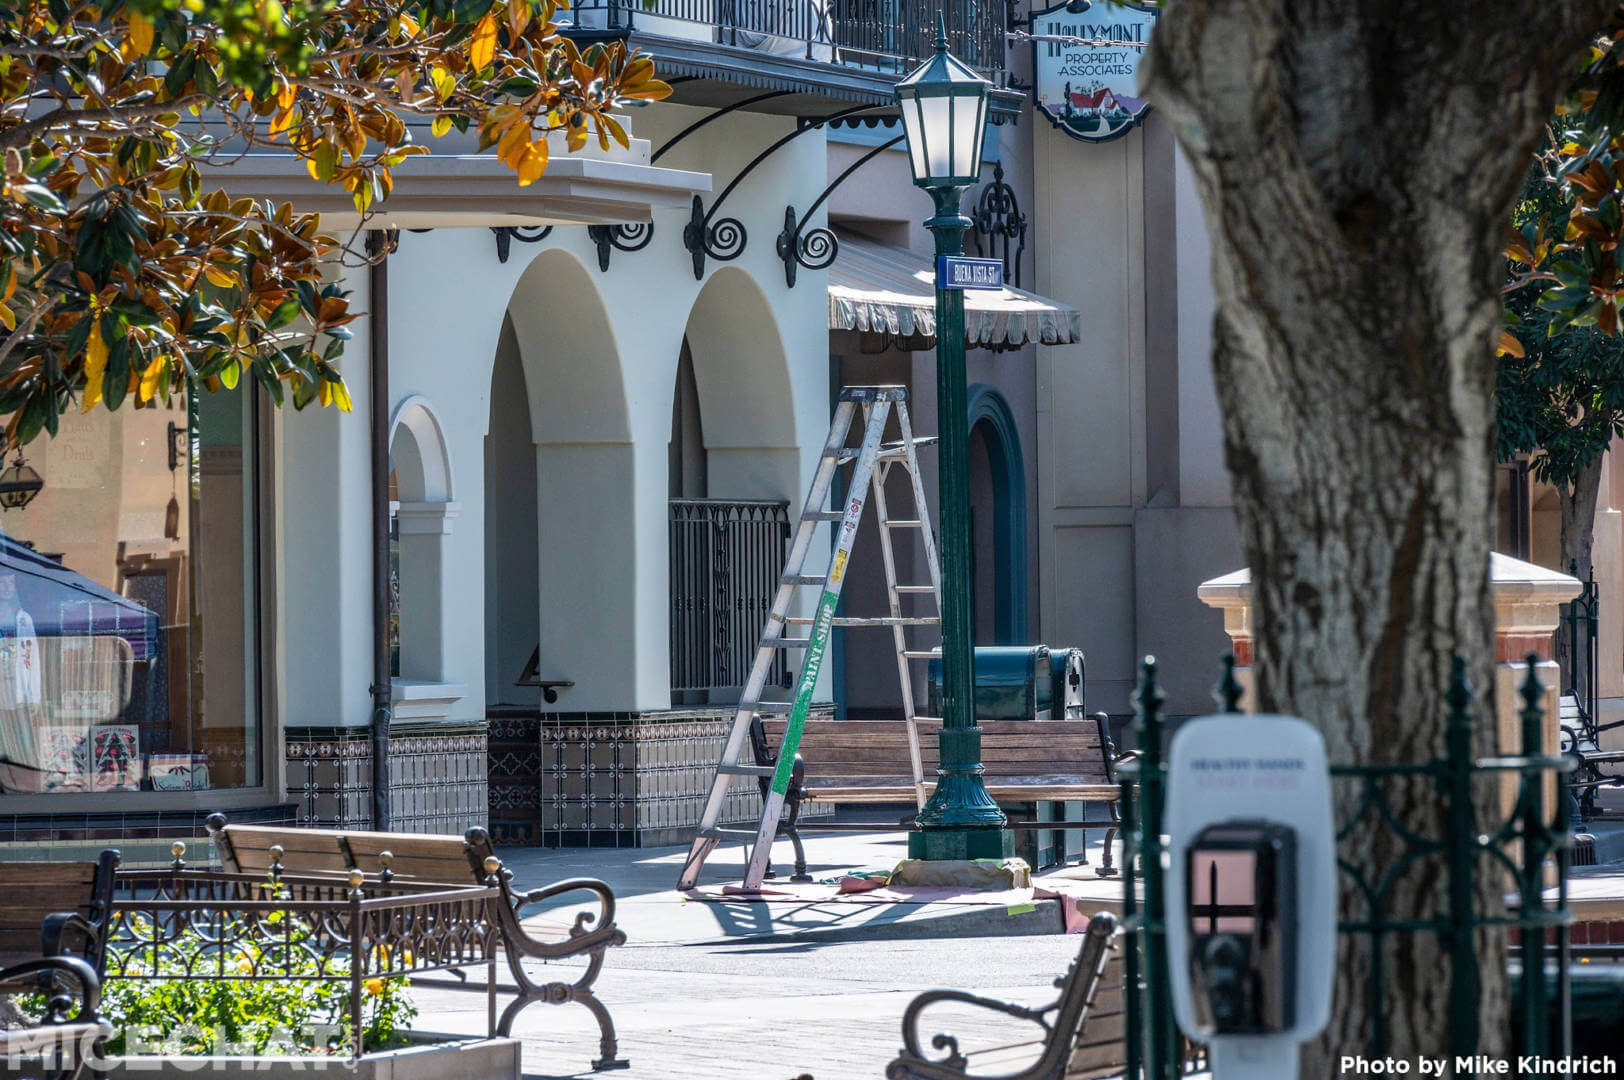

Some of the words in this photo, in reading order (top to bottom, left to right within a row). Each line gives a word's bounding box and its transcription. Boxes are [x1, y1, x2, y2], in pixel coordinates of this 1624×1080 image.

[1066, 53, 1127, 64] PROPERTY
[1057, 65, 1132, 76] ASSOCIATES
[954, 264, 971, 282] BUENA
[973, 265, 987, 283] VISTA
[802, 645, 822, 691] PAINT
[817, 603, 833, 643] SHOP
